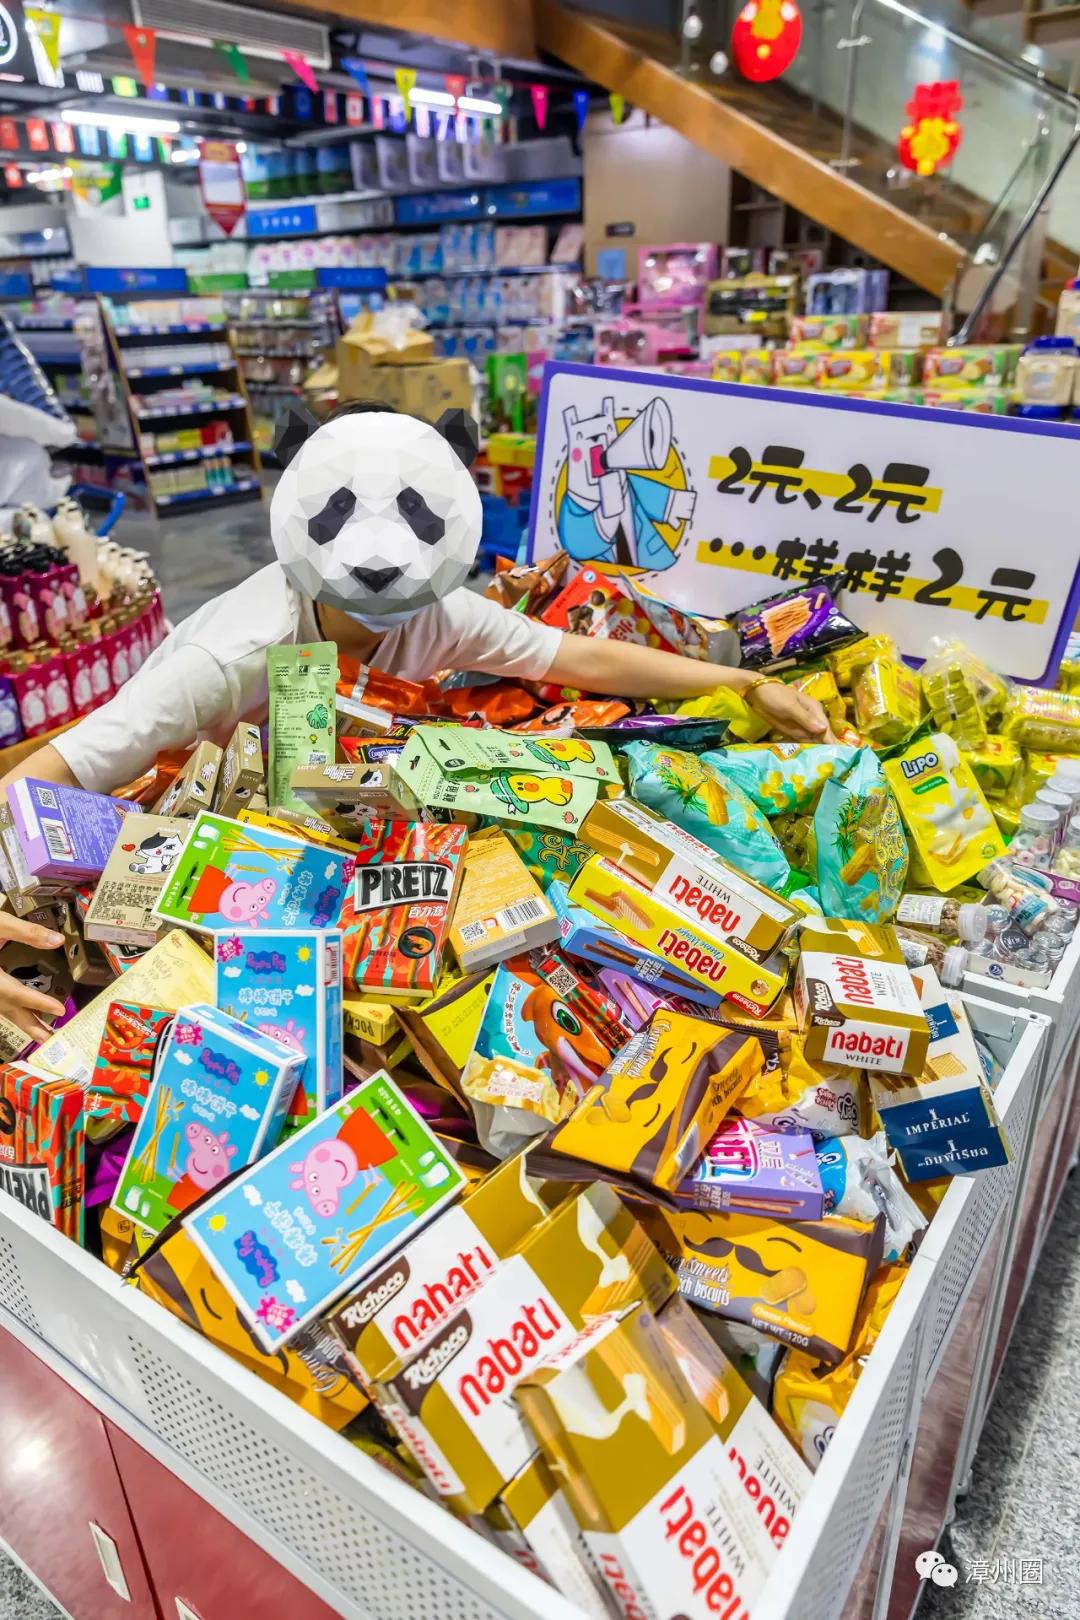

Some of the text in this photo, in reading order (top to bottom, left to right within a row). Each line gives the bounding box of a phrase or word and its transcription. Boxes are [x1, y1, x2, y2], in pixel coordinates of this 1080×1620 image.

[717, 445, 931, 523] 2元、2元
[361, 865, 448, 906] PRETZ
[669, 874, 741, 933] nabati
[696, 874, 731, 903] WHITE
[657, 929, 727, 982] nabati
[832, 956, 875, 1005] nabati
[831, 1030, 903, 1059] nabati
[845, 1053, 882, 1065] WHITE
[905, 1114, 970, 1136] IMPERIAL
[341, 1271, 405, 1328] Richoco
[404, 1326, 468, 1389] Richoco
[458, 1297, 562, 1416] nabati
[757, 1456, 797, 1518] WHITE
[706, 1504, 745, 1577] WHITE
